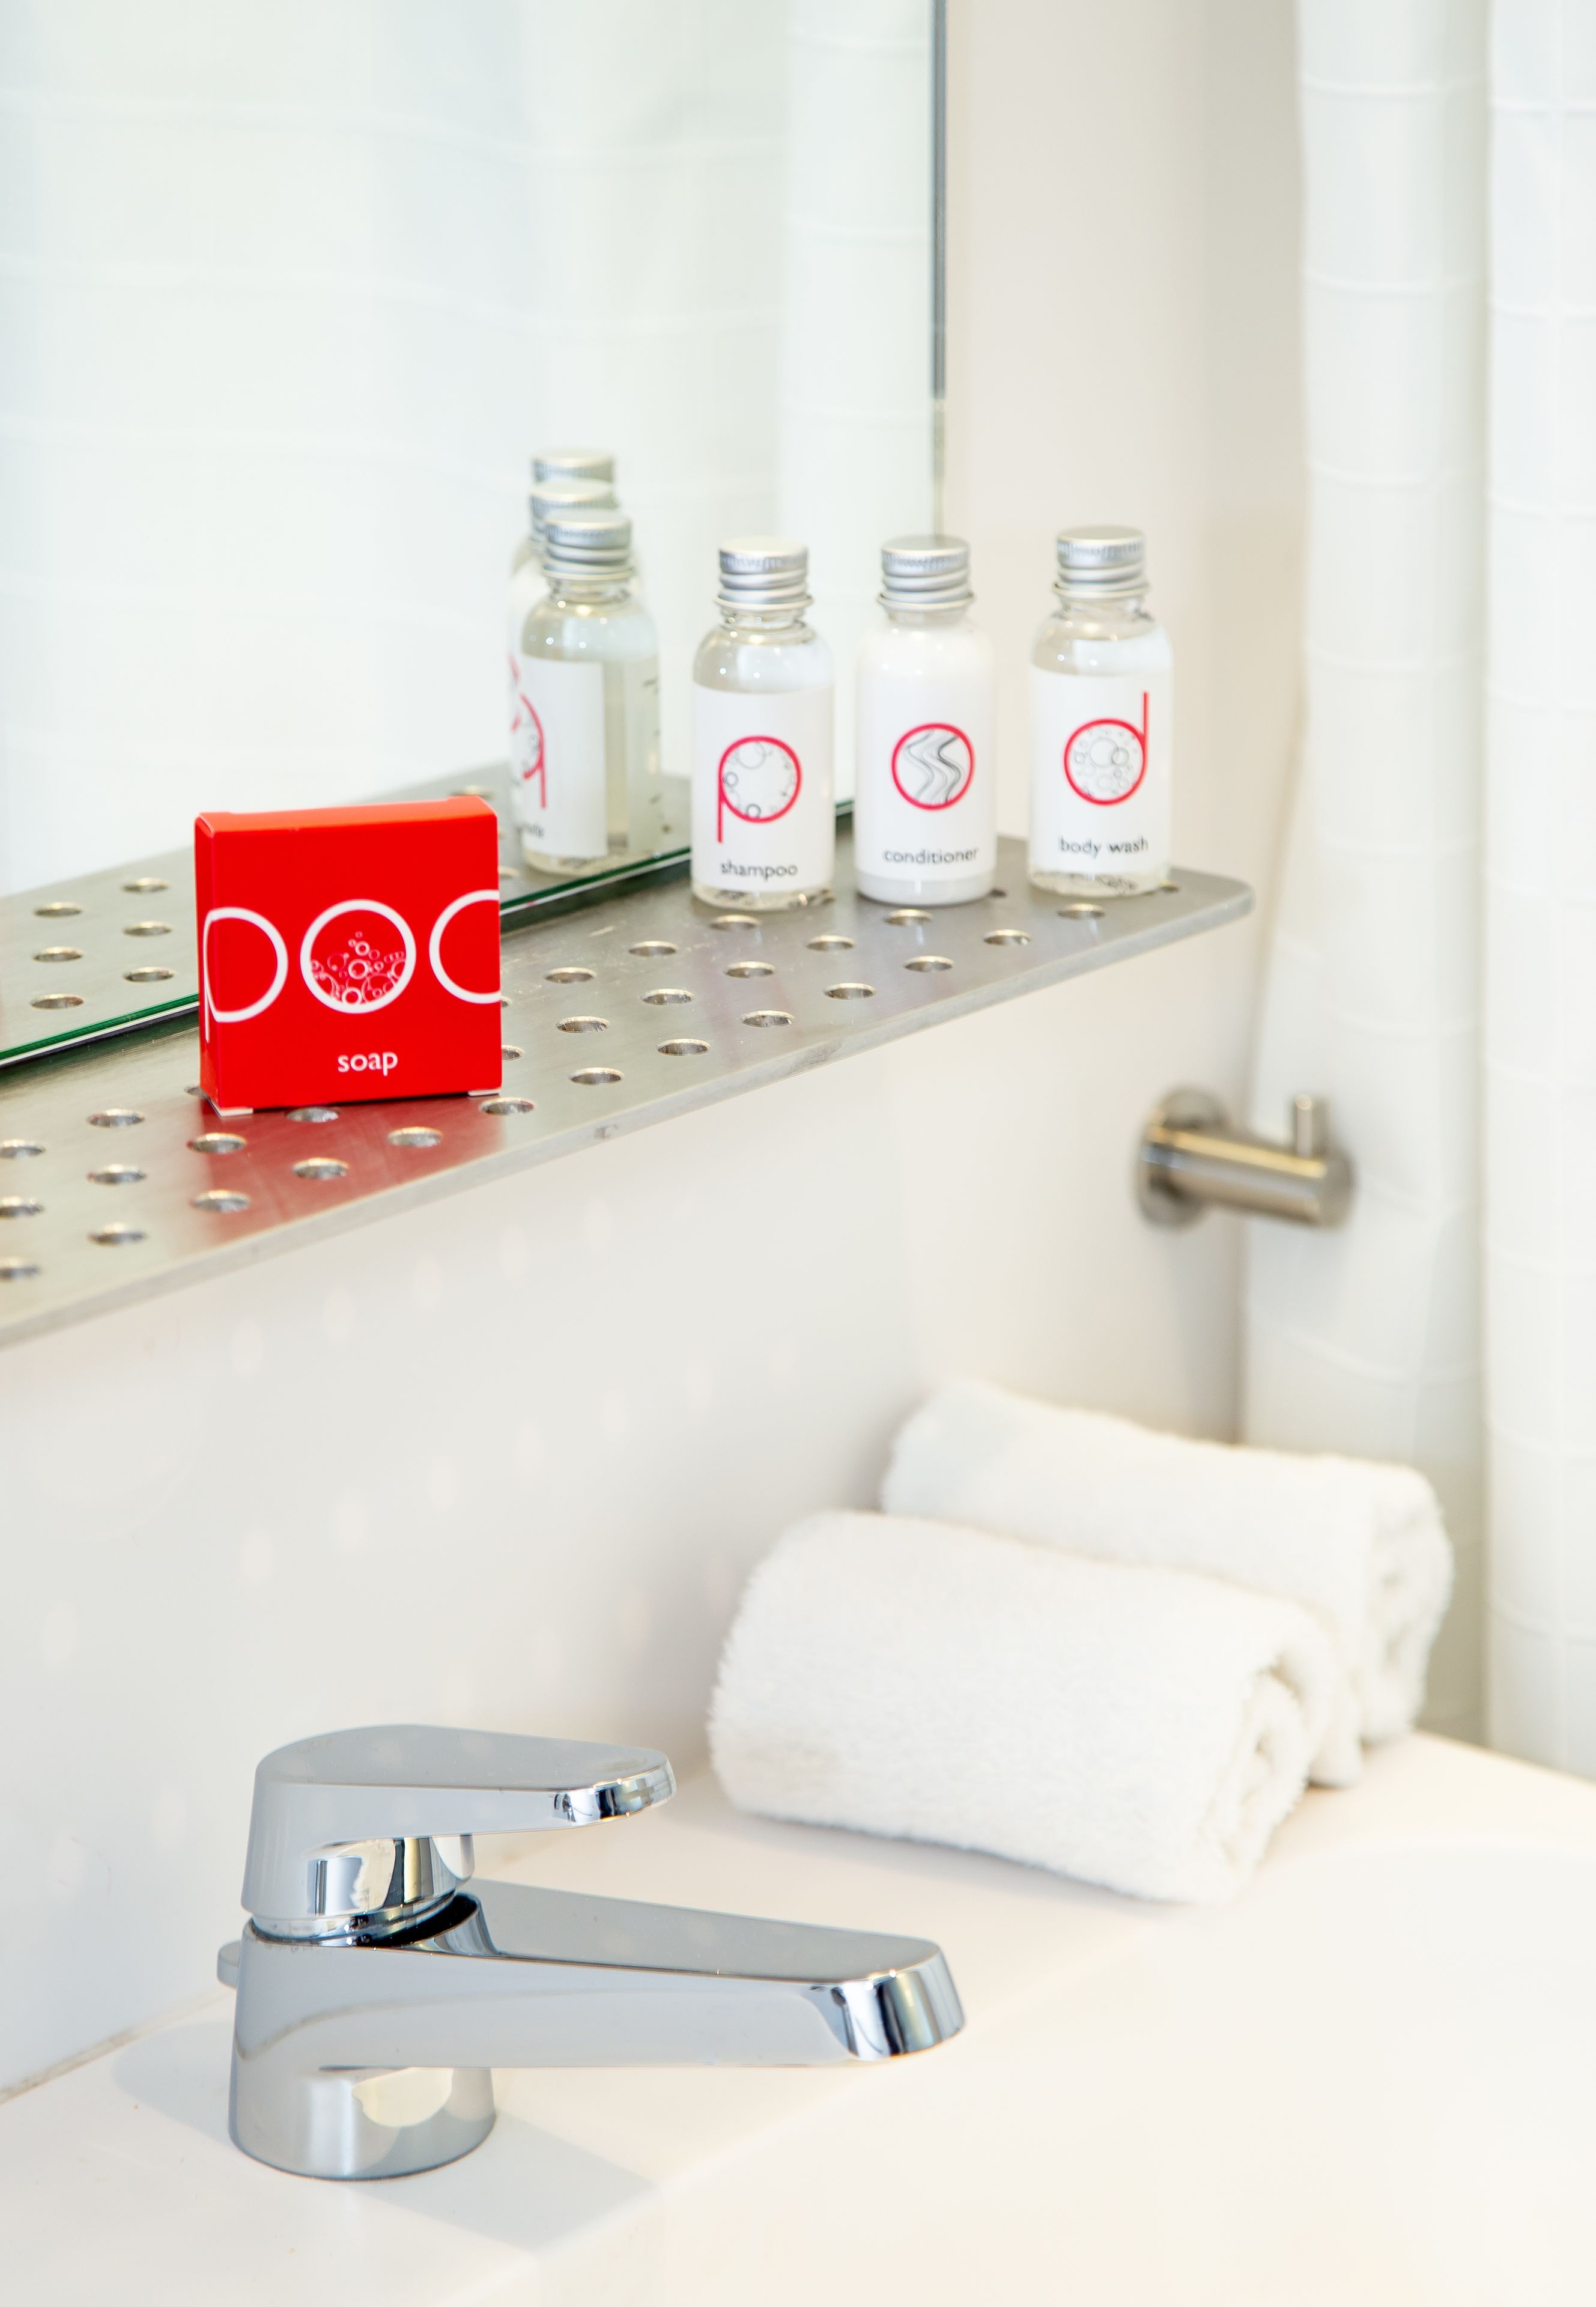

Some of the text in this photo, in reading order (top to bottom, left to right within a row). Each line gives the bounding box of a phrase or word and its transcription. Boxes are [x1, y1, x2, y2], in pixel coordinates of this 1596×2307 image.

[884, 847, 979, 865] conditioner
[1060, 836, 1149, 859] body wash
[720, 859, 798, 881] shampoo
[337, 1051, 398, 1077] soap
